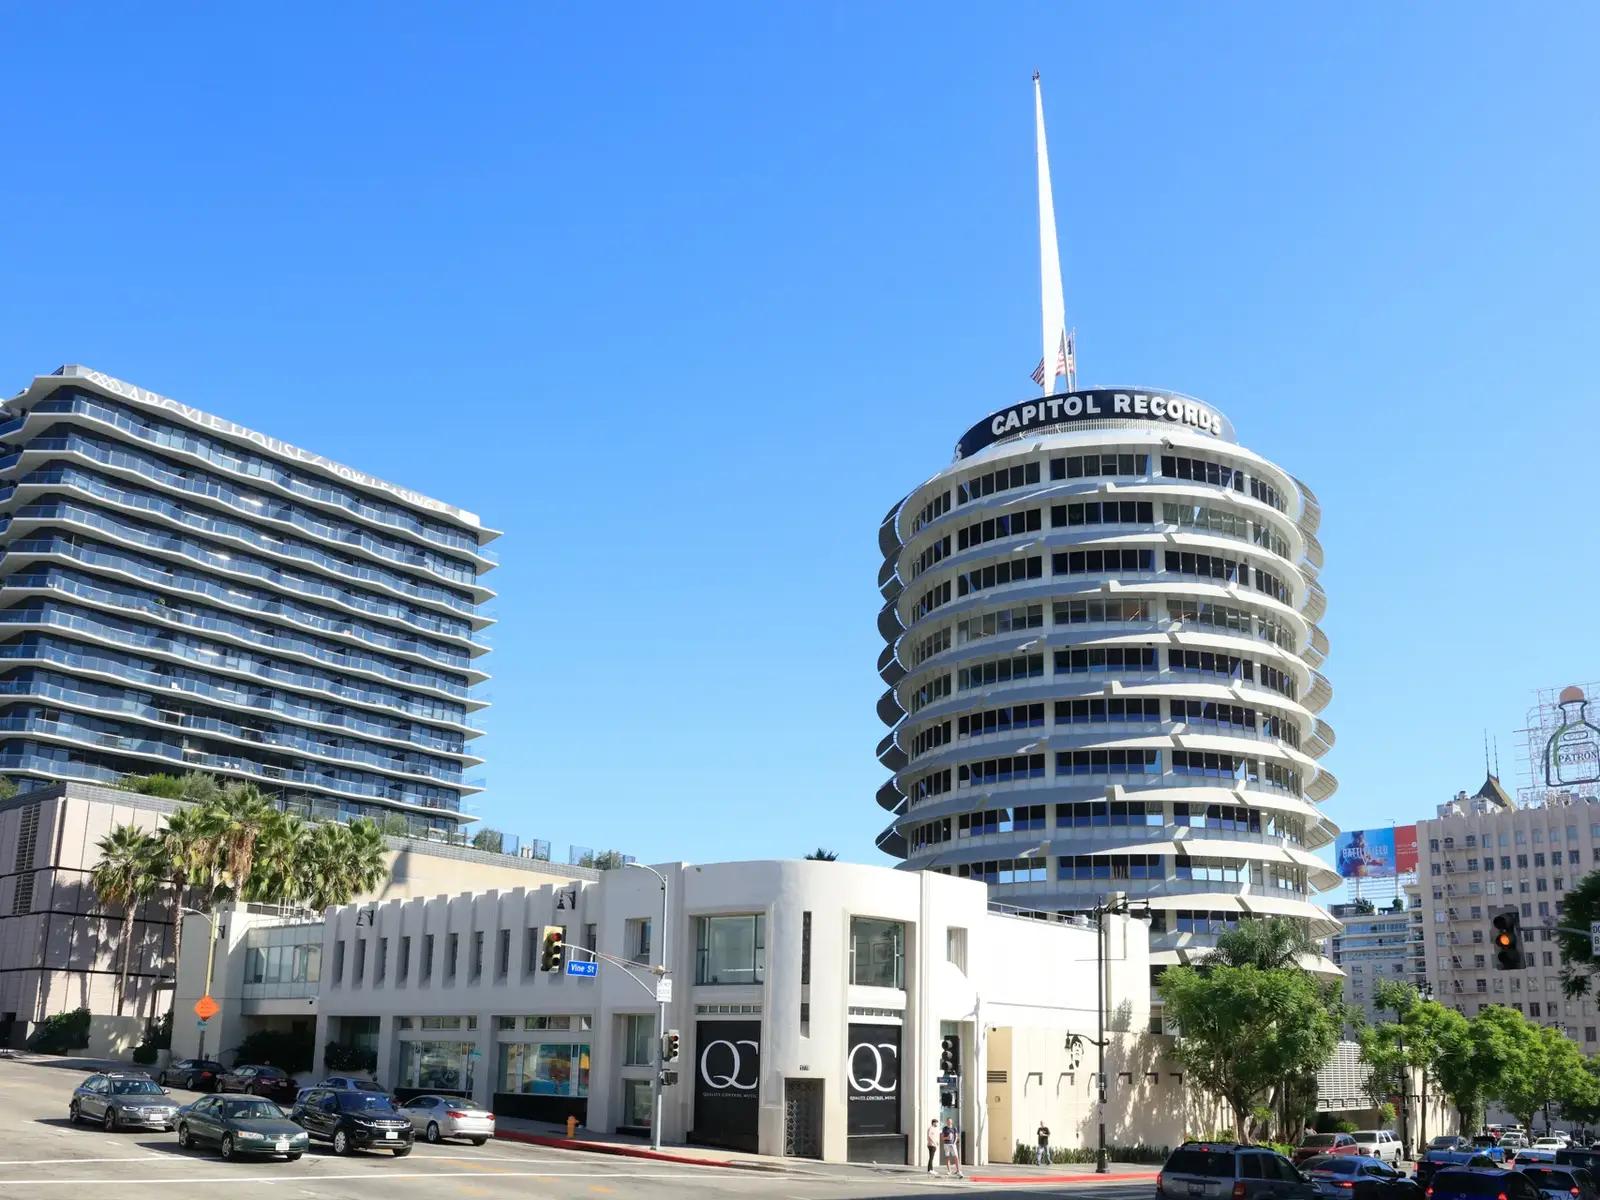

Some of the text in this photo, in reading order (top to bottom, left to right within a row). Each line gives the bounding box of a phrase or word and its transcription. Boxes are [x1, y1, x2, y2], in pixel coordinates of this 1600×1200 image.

[991, 393, 1222, 436] CAPITOL RECORDS
[571, 963, 595, 973] Vine St
